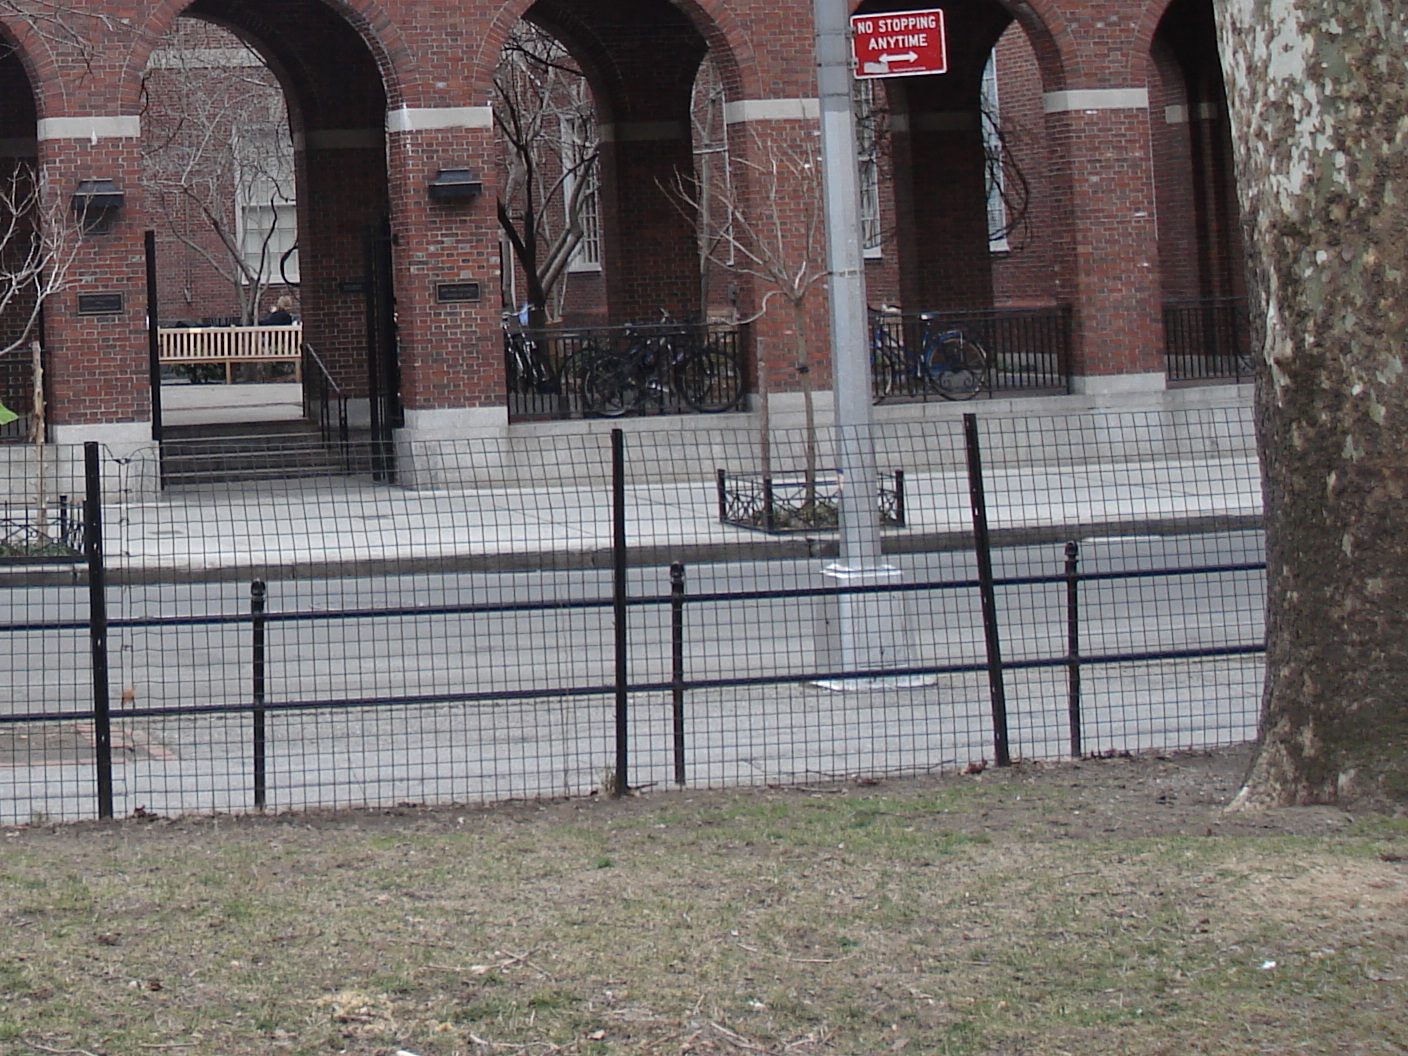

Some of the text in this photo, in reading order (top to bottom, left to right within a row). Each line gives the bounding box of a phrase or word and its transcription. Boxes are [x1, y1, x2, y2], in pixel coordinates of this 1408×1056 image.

[857, 16, 936, 34] NO STOPPING
[868, 34, 928, 51] ANYTIME
